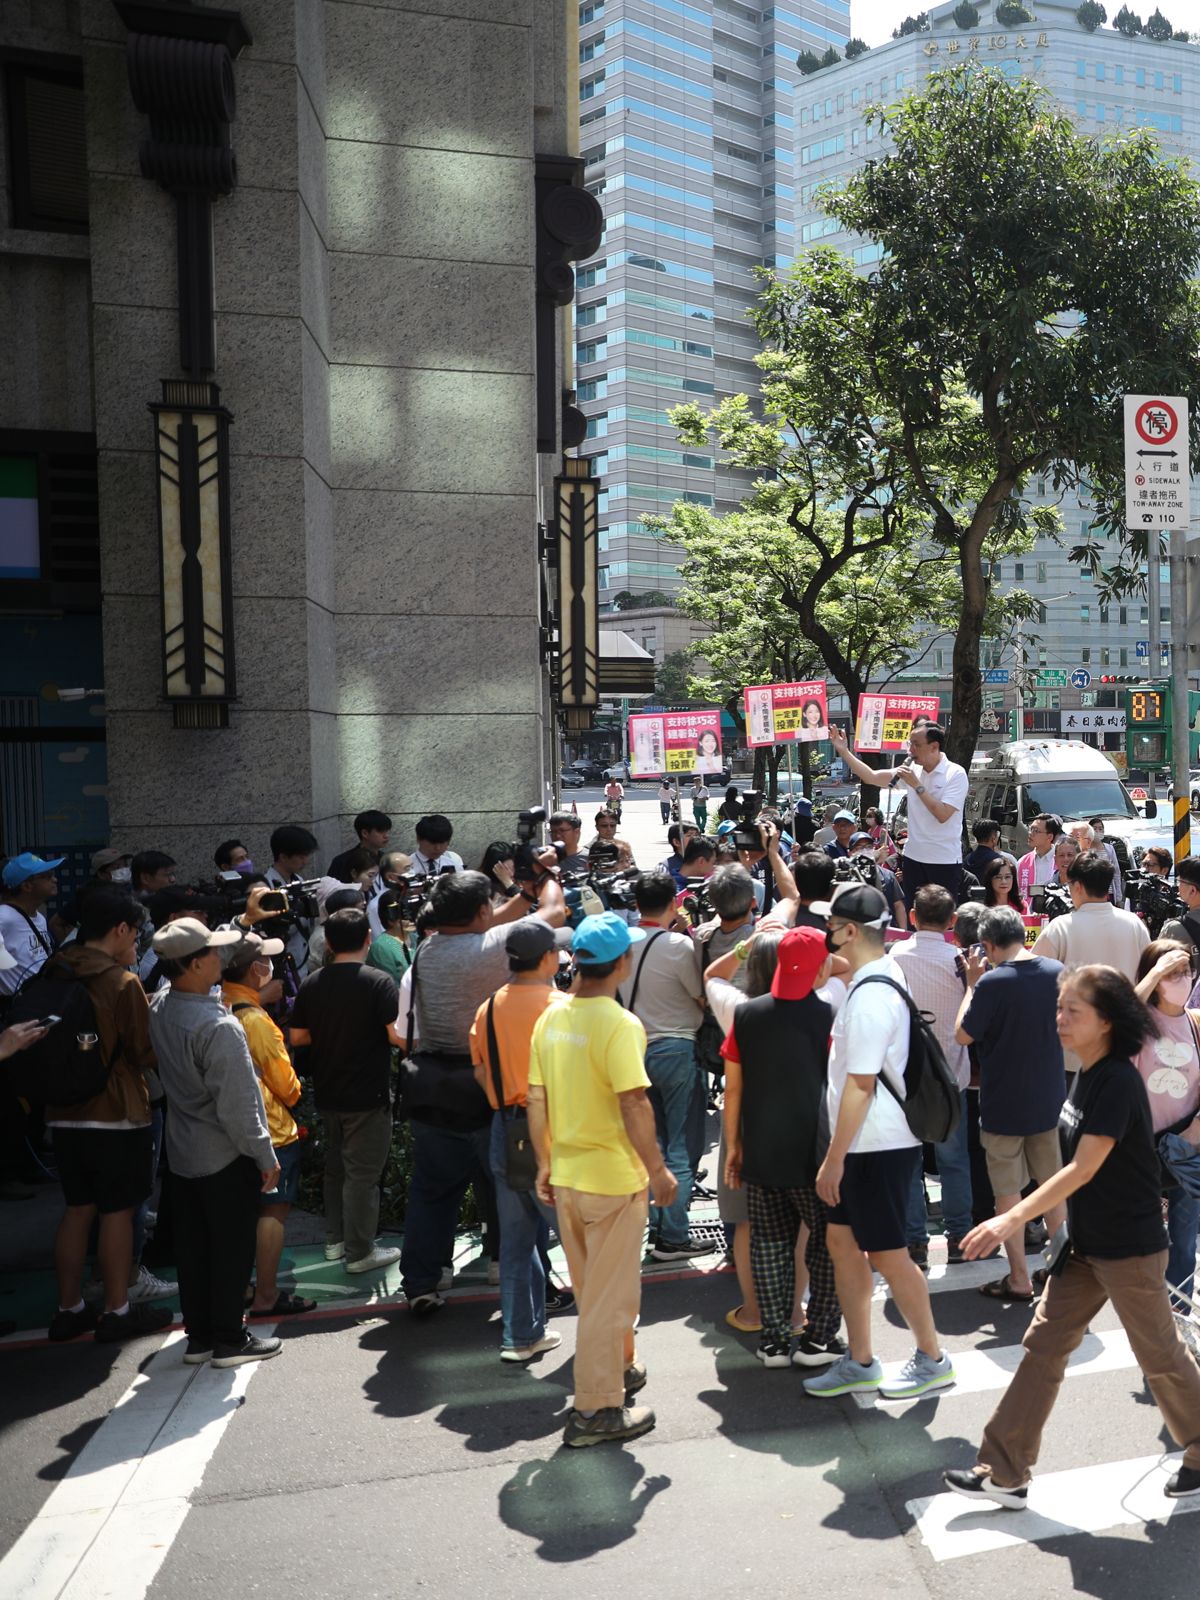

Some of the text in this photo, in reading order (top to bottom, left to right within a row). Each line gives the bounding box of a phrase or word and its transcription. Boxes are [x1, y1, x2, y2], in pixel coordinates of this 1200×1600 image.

[1145, 410, 1168, 435] 停
[1136, 461, 1179, 473] 人行道
[1148, 477, 1181, 485] SIDEWALK
[1139, 490, 1178, 500] 違者拖吊
[1133, 500, 1165, 508] TOW-AWAY
[1159, 514, 1175, 523] 110
[887, 698, 936, 711] 支持徐巧芯
[1132, 692, 1160, 721] 87
[775, 709, 799, 718] 一定要
[886, 721, 909, 729] 一定要
[669, 750, 694, 759] 一定要
